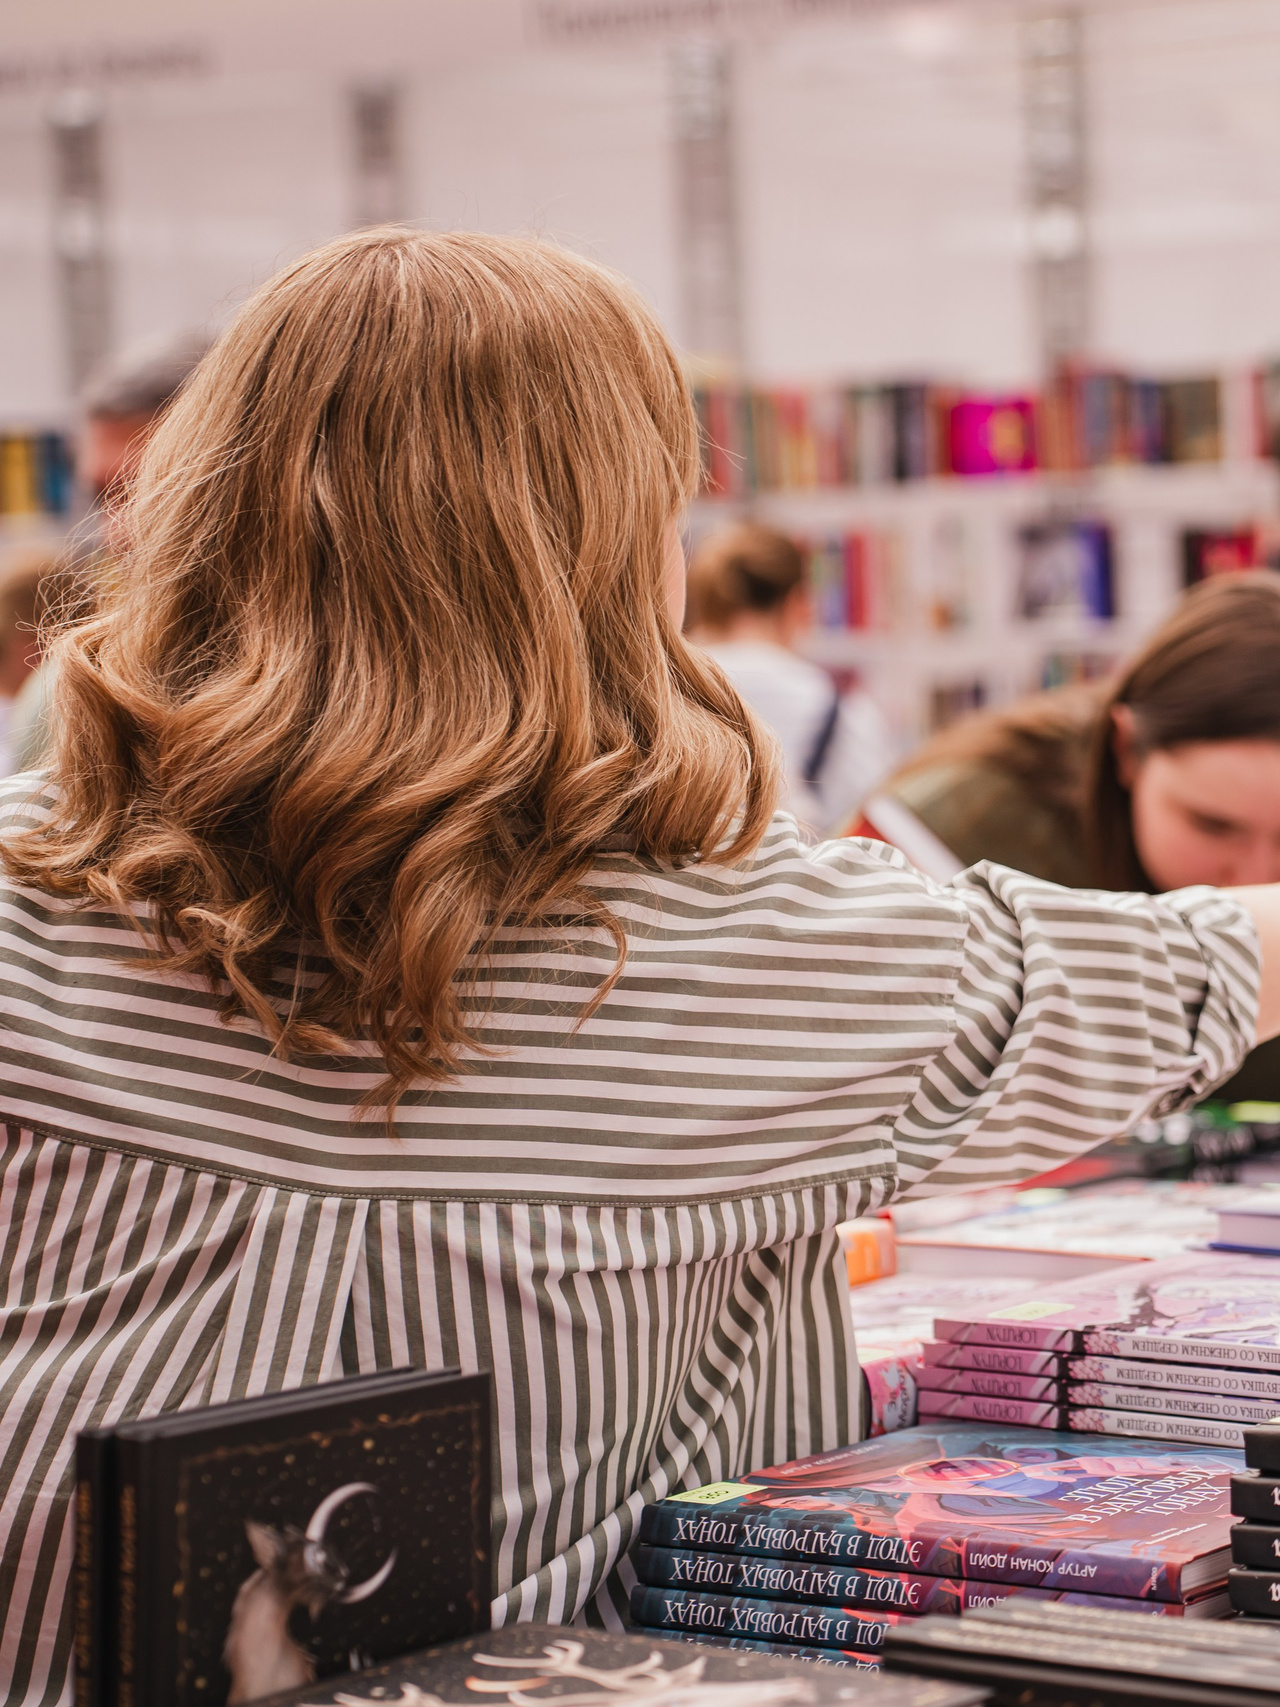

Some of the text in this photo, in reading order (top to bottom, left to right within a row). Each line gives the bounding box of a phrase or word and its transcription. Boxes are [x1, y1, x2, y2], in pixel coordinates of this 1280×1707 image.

[985, 1327, 1039, 1344] LOPUTYN
[1132, 1340, 1179, 1354] СЕРДЦЕМ
[1182, 1345, 1234, 1359] СНЕЖНЫМ
[1236, 1350, 1254, 1361] СО
[971, 1353, 1024, 1370] LOPUTYN
[1116, 1368, 1163, 1382] СЕРДЦЕМ
[1165, 1372, 1218, 1388] СНЕЖНЫМ
[1220, 1377, 1239, 1389] СО
[971, 1378, 1023, 1395] LOPUTYN
[1115, 1394, 1162, 1409] СЕРДЦЕМ
[1165, 1399, 1219, 1414] СНЕЖНЫМ
[1223, 1404, 1239, 1416] СО
[971, 1402, 1024, 1420] LOPUTYN
[1116, 1418, 1239, 1440] СО СНЕЖНЫМ СЕРДЦЕМ
[1058, 1475, 1155, 1504] ЭТЮД
[1063, 1465, 1231, 1524] В БАГРОВЫХ
[1135, 1482, 1232, 1516] ТОНАХ
[672, 1516, 924, 1564] ЭТЮД В БАГРОВЫХ ТОНАХ
[969, 1553, 1098, 1578] АРТУР КОНАН ДОЙЛ
[669, 1556, 921, 1605] ЭТЮД В БАГРОВЫХ ТОНАХ
[663, 1599, 890, 1645] ЮД В БАГРОВЫХ ТОНАХ
